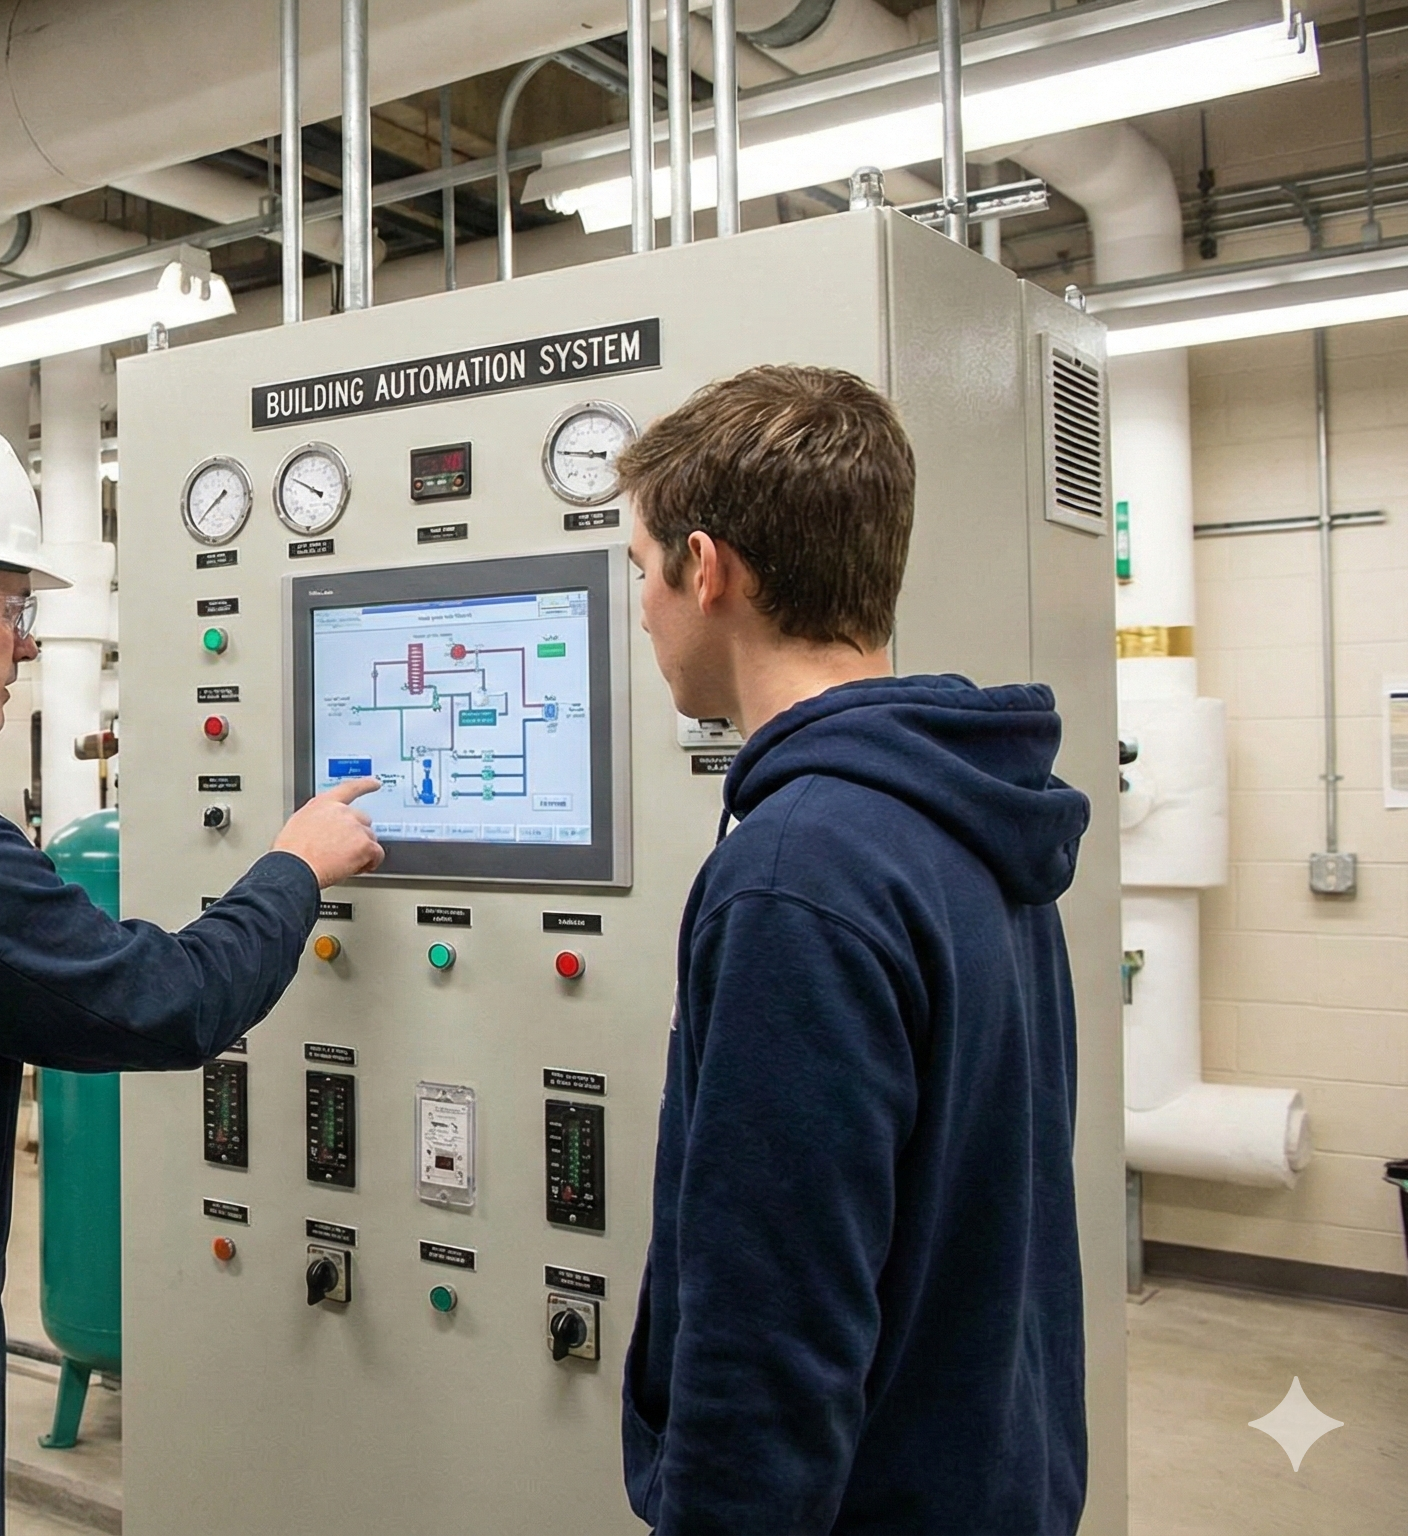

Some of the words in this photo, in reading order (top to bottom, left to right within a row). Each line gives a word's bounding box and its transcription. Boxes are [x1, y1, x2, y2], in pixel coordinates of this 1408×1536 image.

[266, 377, 364, 419] BUILDING
[374, 349, 526, 402] AUTOMATION
[539, 329, 640, 375] SYSTEM
